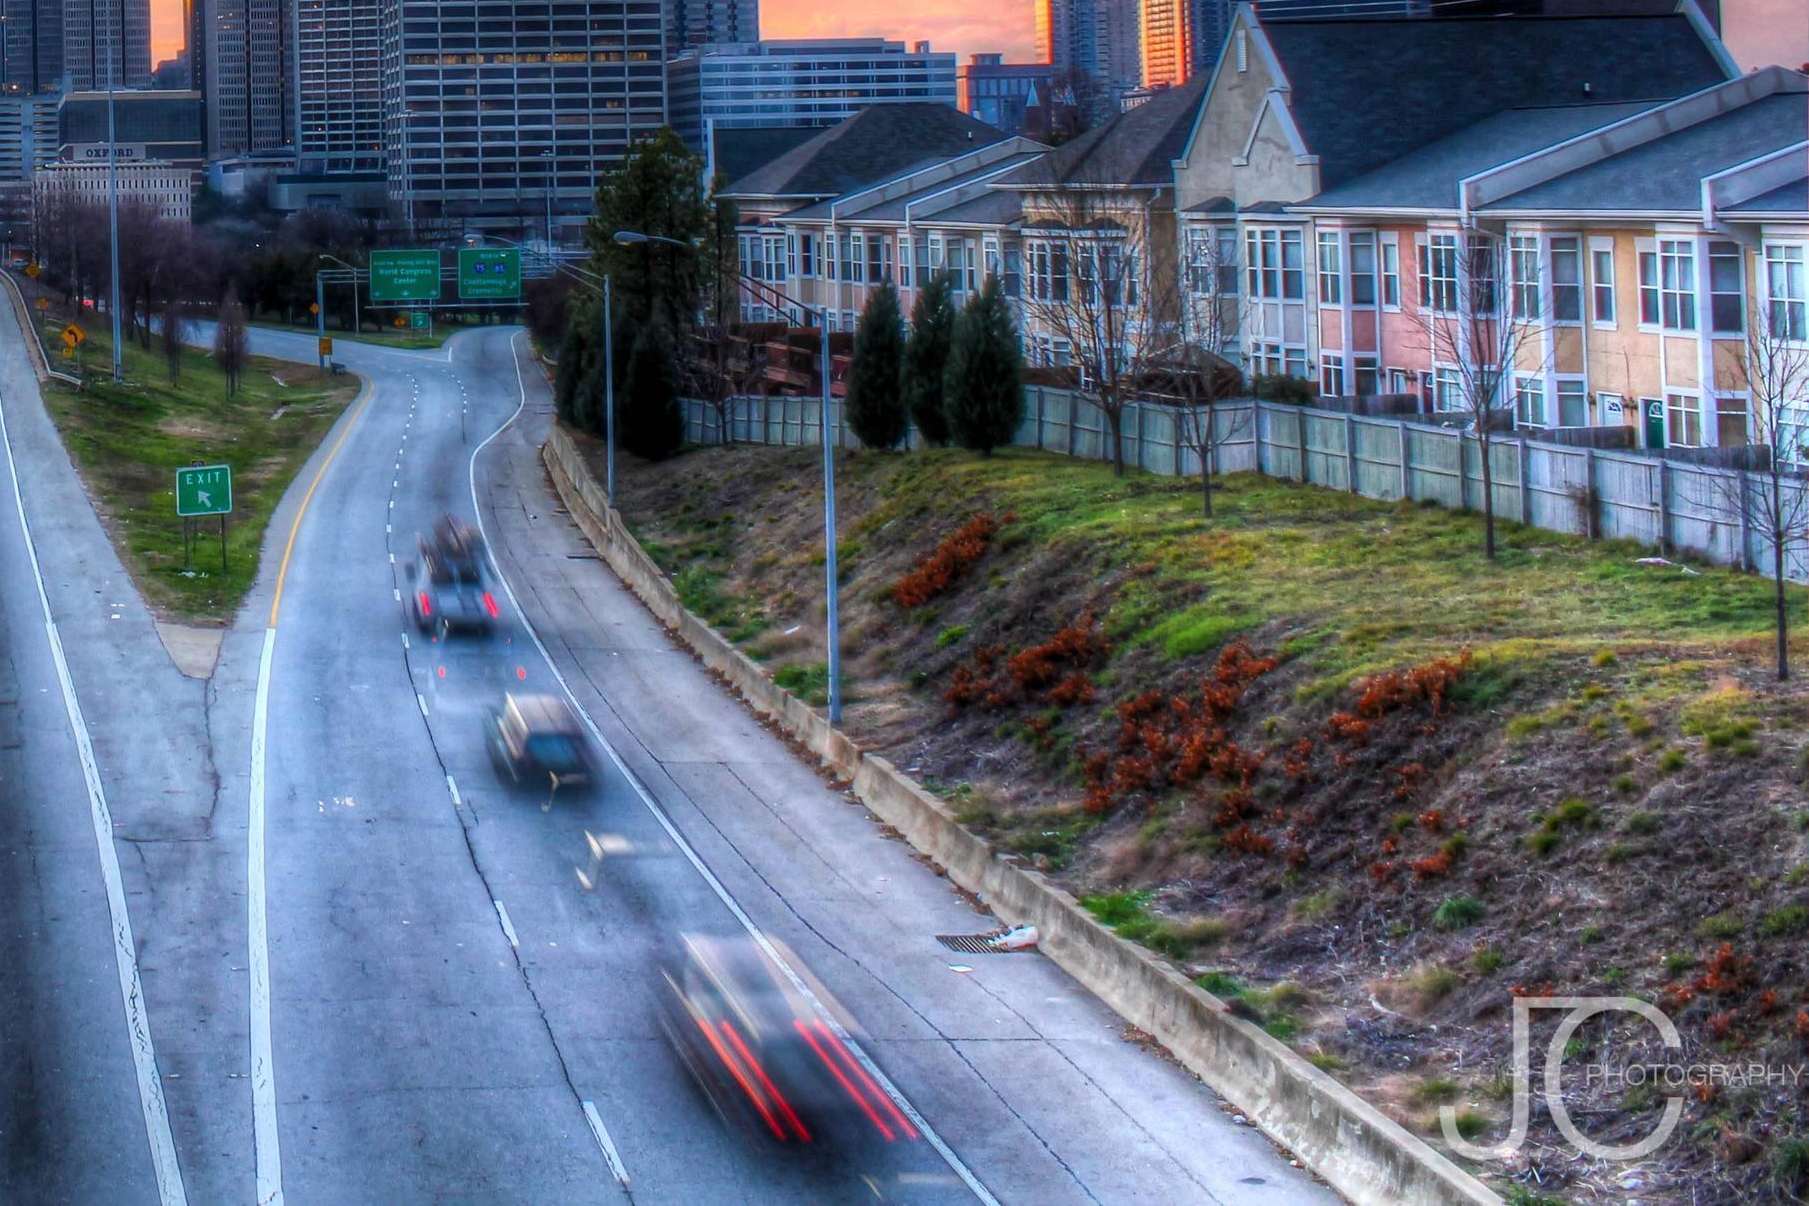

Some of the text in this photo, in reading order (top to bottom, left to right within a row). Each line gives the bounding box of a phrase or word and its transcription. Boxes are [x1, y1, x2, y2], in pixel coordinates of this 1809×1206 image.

[400, 268, 433, 277] Congress
[475, 264, 486, 273] 75
[393, 277, 417, 285] Center
[186, 471, 221, 485] EXIT
